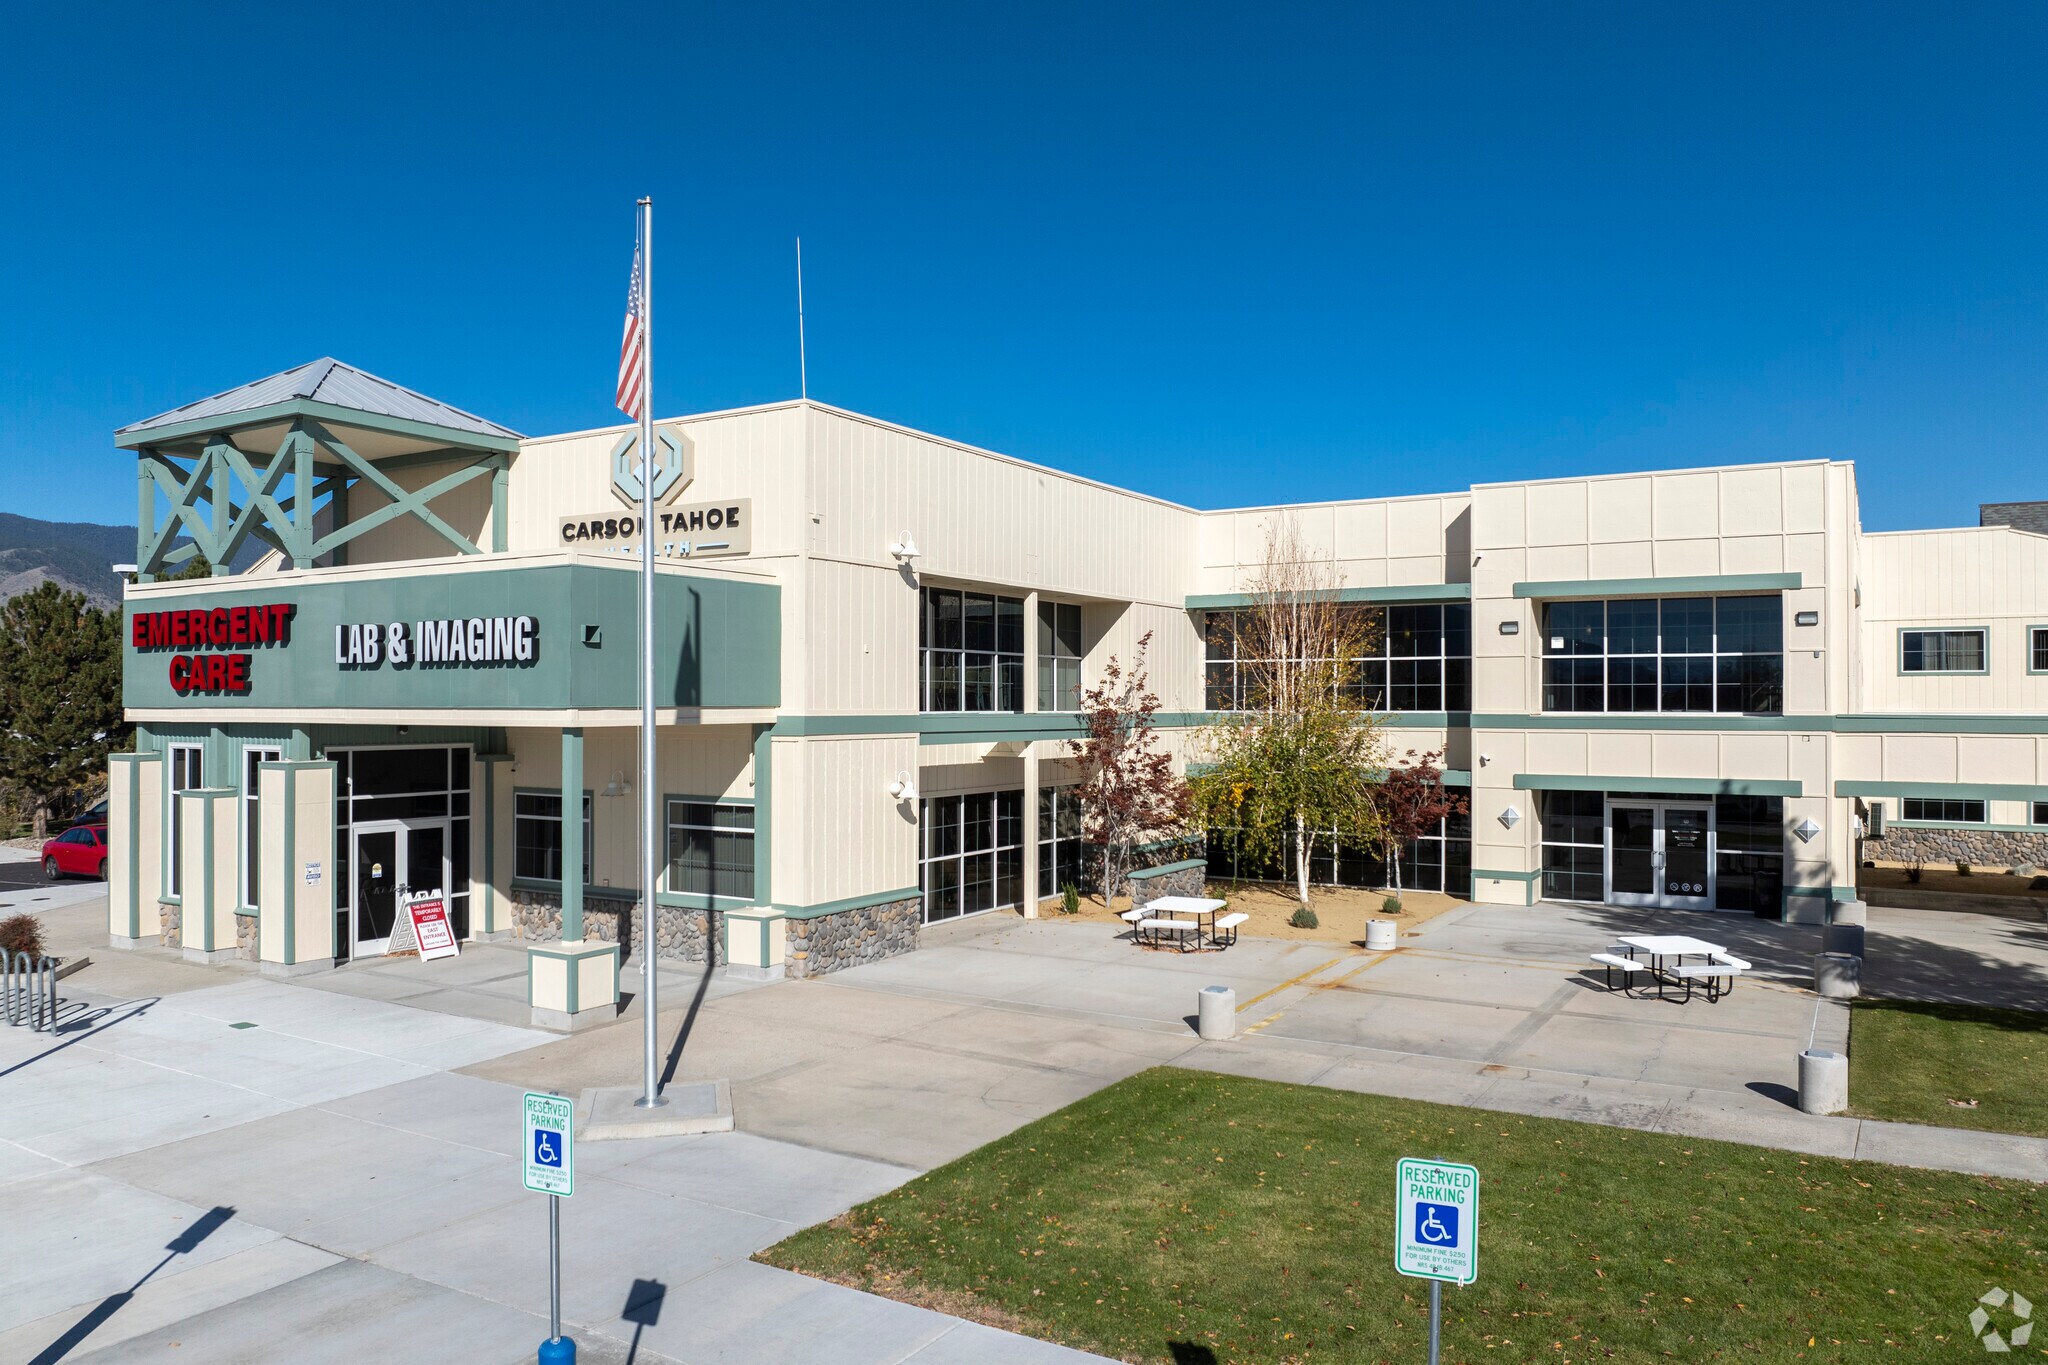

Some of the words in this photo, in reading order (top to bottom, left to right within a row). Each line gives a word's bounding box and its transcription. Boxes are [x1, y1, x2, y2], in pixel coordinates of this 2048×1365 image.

[660, 507, 740, 533] TAHOE
[132, 603, 296, 650] EMERGENT
[335, 622, 383, 668] LAB
[387, 621, 412, 666] &
[416, 615, 537, 665] IMAGING
[169, 653, 250, 695] CARE
[422, 914, 438, 922] CLOSED
[423, 932, 446, 940] ENTRANCE
[527, 1099, 569, 1118] RESERVED
[531, 1113, 566, 1131] PARKING
[1405, 1166, 1472, 1189] RESERVED
[1410, 1183, 1465, 1205] PARKING
[1405, 1252, 1418, 1260] FOR
[1418, 1254, 1431, 1262] USE
[1442, 1257, 1468, 1267] OTHERS
[1406, 1245, 1433, 1254] MINIMUM
[1433, 1248, 1448, 1256] FINE
[1449, 1250, 1466, 1259] $250
